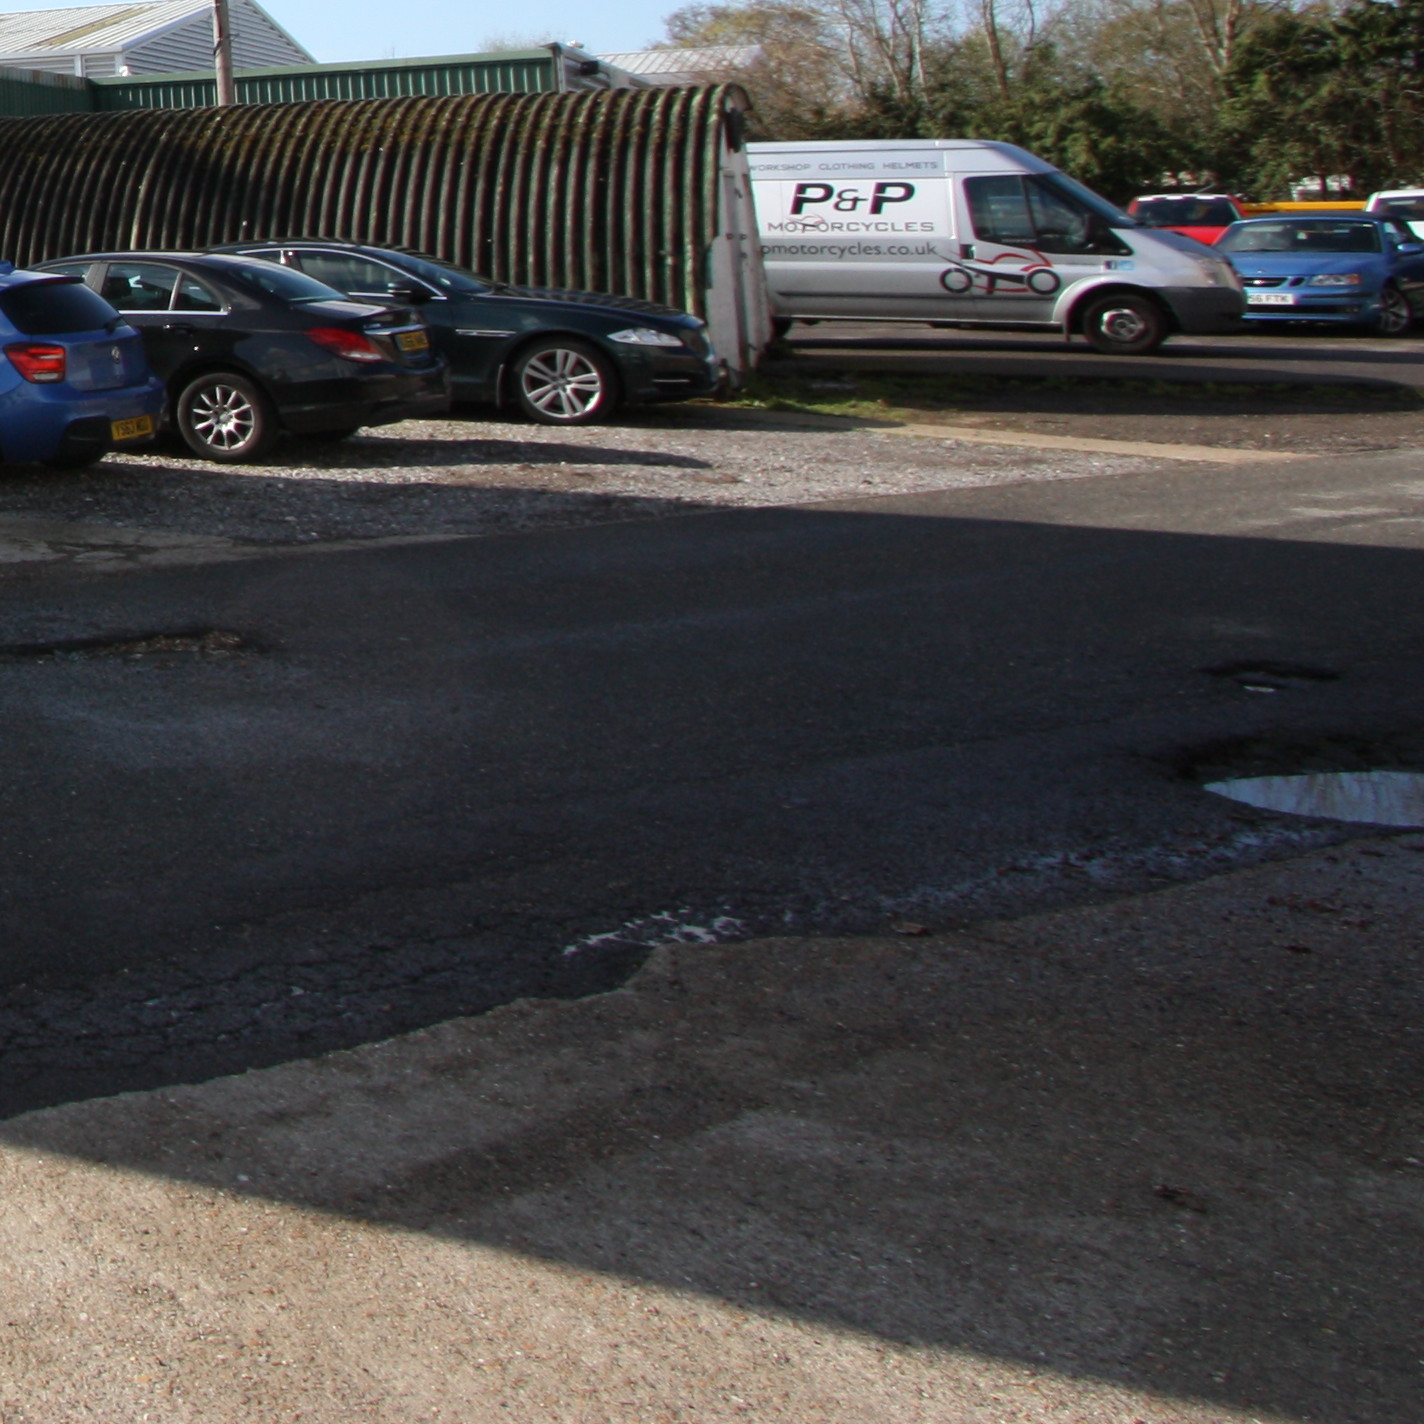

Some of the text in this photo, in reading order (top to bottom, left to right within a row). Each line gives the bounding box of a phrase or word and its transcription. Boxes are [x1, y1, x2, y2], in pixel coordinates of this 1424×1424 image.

[818, 162, 875, 171] CLOTHING
[882, 161, 938, 170] HELMETS
[790, 181, 916, 215] P&P
[767, 221, 935, 233] MOTORCYCLES
